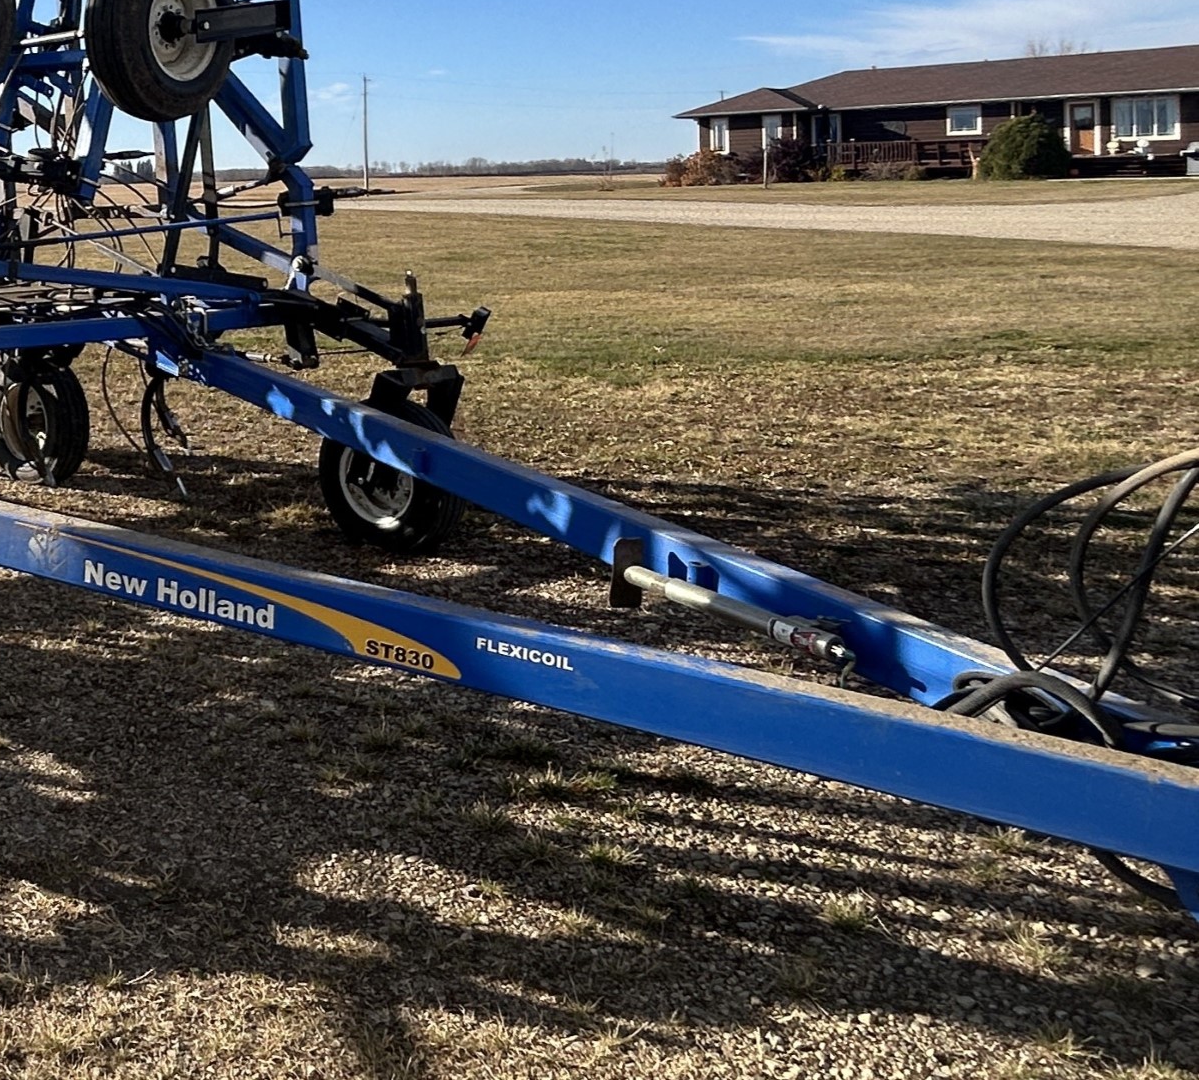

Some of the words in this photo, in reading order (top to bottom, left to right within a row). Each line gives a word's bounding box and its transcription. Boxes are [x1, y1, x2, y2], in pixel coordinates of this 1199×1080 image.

[84, 559, 147, 597] New
[157, 577, 275, 630] Holland
[365, 639, 434, 670] ST830
[476, 637, 574, 671] FLEXICOIL
